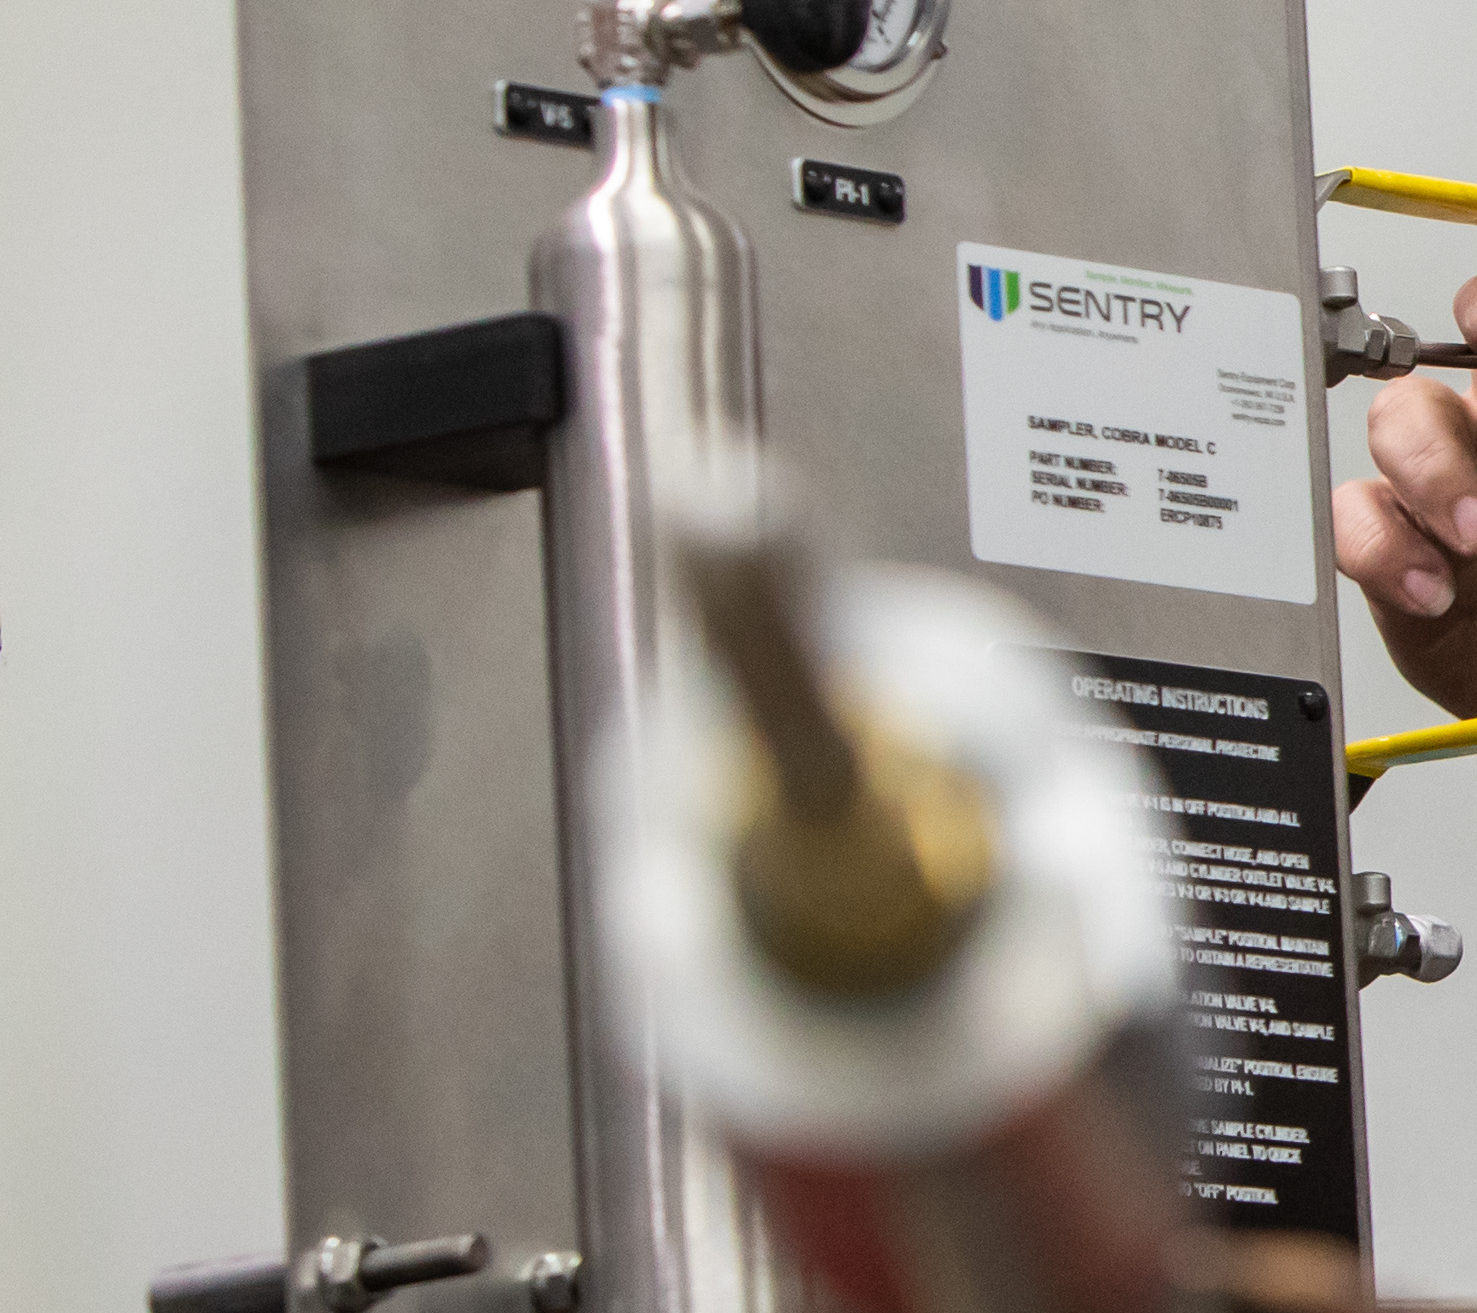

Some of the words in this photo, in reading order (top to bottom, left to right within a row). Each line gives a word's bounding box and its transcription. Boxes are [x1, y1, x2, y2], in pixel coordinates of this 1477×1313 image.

[1029, 281, 1192, 334] SENTRY
[1027, 415, 1098, 439] SAMPLER,
[1101, 426, 1151, 446] COBRA
[1154, 433, 1203, 454] MODEL
[1206, 441, 1217, 456] C
[1029, 450, 1060, 466] PART
[1030, 470, 1072, 489] SERIAL
[1031, 490, 1049, 505] PO
[1071, 675, 1159, 706] OPERATING
[1161, 685, 1270, 721] INSTRUCTIONS
[1159, 731, 1215, 755] PERSONAL
[1215, 738, 1280, 762] PROTECTIVE
[1185, 798, 1206, 816] OFF
[1207, 801, 1256, 822] POSITION
[1256, 808, 1279, 825] AND
[1280, 811, 1301, 828] ALL
[1171, 839, 1222, 859] CONNECT
[1255, 849, 1279, 867] AND
[1280, 853, 1311, 870] OPEN
[1164, 859, 1187, 877] AND
[1188, 863, 1242, 883] CYLINDER
[1242, 870, 1283, 888] OUTLET
[1284, 874, 1317, 892] VALVE
[1196, 885, 1213, 901] OR
[1230, 889, 1247, 905] OR
[1287, 895, 1332, 915] SAMPLE
[1280, 936, 1331, 956] MAINTAIN
[1196, 948, 1236, 967] OBTAIN
[1236, 952, 1245, 968] A
[1245, 953, 1335, 978] REPRESENTATIVE
[1225, 993, 1258, 1012] VALVE
[1214, 1014, 1250, 1032] VALVE
[1269, 1019, 1292, 1037] AND
[1292, 1021, 1335, 1042] SAMPLE
[1214, 1077, 1230, 1093] BY
[1296, 1064, 1339, 1084] ENSURE
[1211, 1120, 1255, 1139] SAMPLE
[1255, 1124, 1311, 1144] CYLINDER.
[1198, 1140, 1214, 1155] ON
[1216, 1142, 1252, 1159] PANEL
[1252, 1144, 1268, 1161] TO
[1268, 1146, 1303, 1164] QUICK
